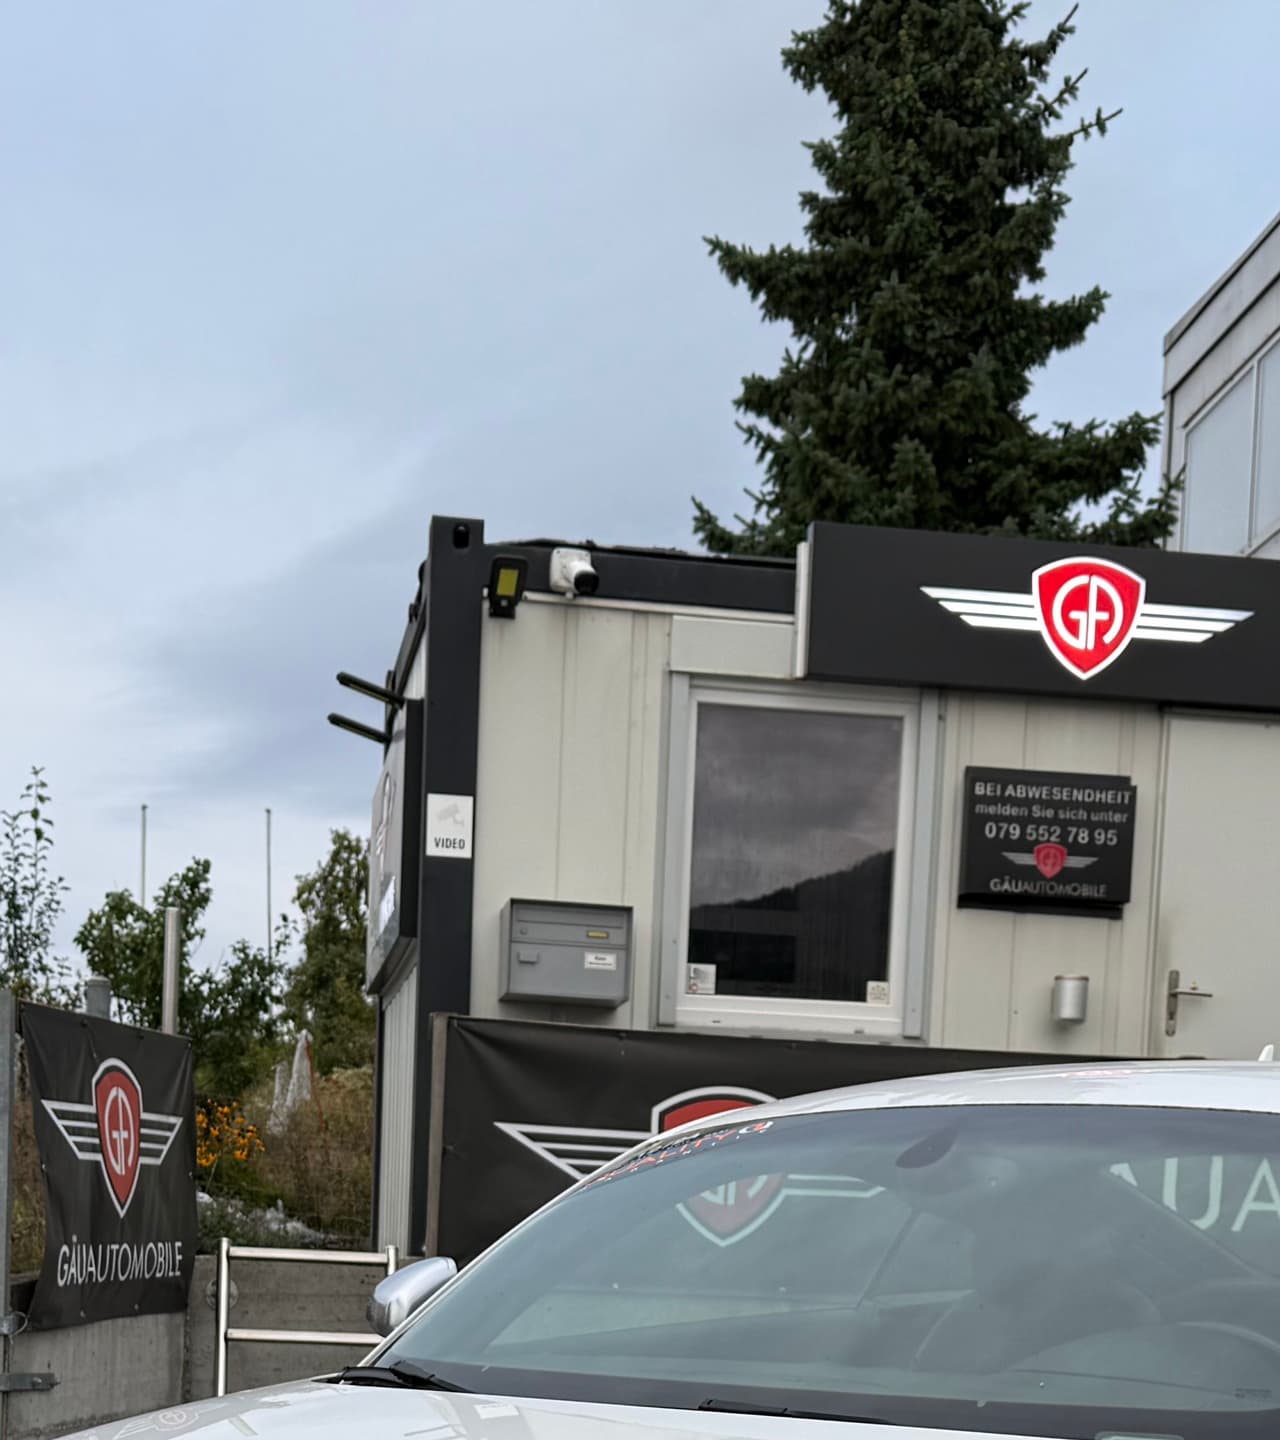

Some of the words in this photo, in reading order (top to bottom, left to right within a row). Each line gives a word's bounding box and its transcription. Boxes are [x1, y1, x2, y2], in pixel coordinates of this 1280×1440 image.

[974, 782, 1001, 796] BEI
[1004, 784, 1132, 804] ABWESENDHEIT
[975, 803, 1028, 817] melden
[1032, 804, 1054, 818] Sie
[1058, 807, 1088, 821] sich
[1090, 810, 1128, 823] unter
[434, 836, 466, 850] VIDEO
[984, 822, 1021, 840] 079
[1026, 825, 1061, 842] 552
[1067, 827, 1089, 844] 78
[1094, 829, 1118, 846] 95
[990, 876, 1107, 897] GÄUAUTOMOBILE
[57, 1235, 183, 1288] GÄUAUTOMOBILE
